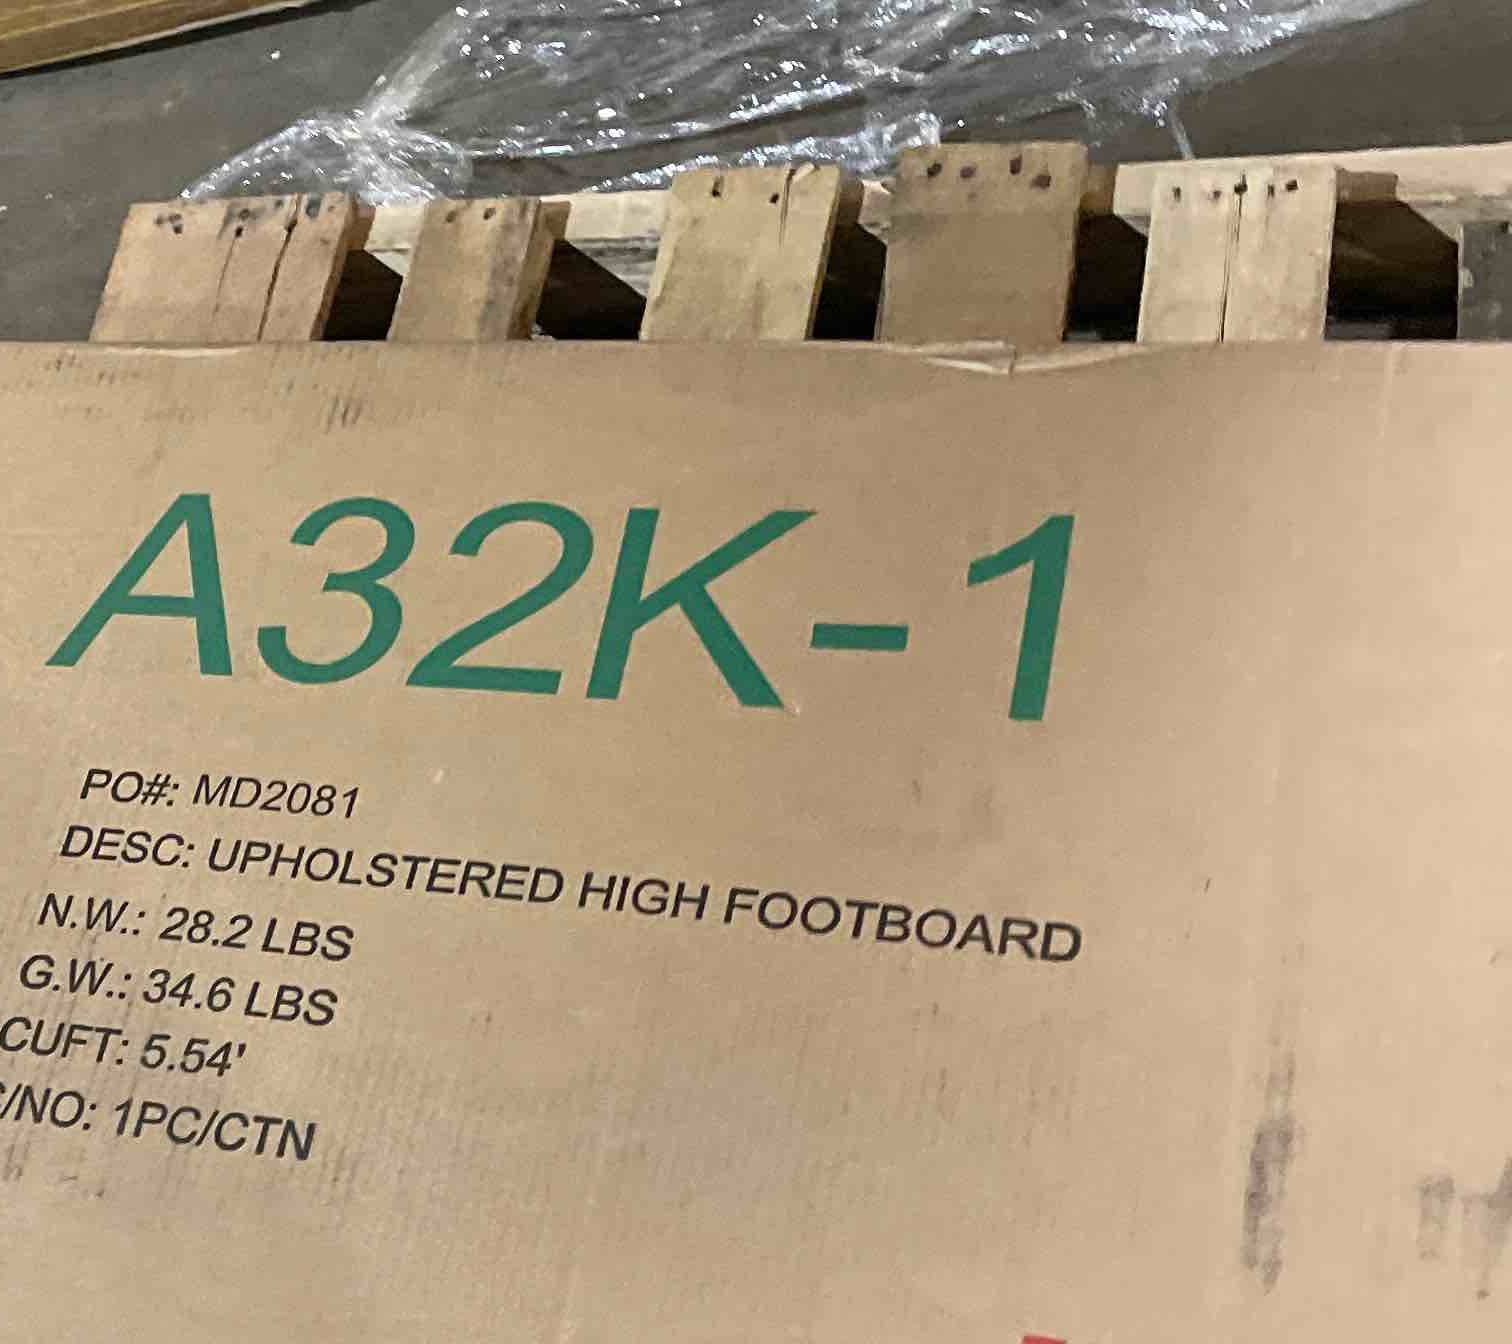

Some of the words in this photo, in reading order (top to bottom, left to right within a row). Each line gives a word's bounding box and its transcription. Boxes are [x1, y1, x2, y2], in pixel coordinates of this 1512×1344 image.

[44, 492, 1075, 722] A32K-1
[80, 768, 180, 807] PO#:
[192, 773, 360, 819] MD2081
[38, 892, 147, 936] N.W.:
[158, 906, 254, 950] 28.2
[261, 917, 356, 962] LBS
[60, 824, 195, 868] DESC:
[207, 837, 564, 905] UPHOLSTERED
[577, 871, 711, 921] HIGH
[723, 886, 1083, 963] FOOTBOARD
[19, 954, 133, 1000] G.W.:
[142, 968, 237, 1012] 34.6
[244, 981, 339, 1026] LBS
[139, 1033, 248, 1077] 5.54'
[114, 1097, 317, 1160] 1PC/CTN
